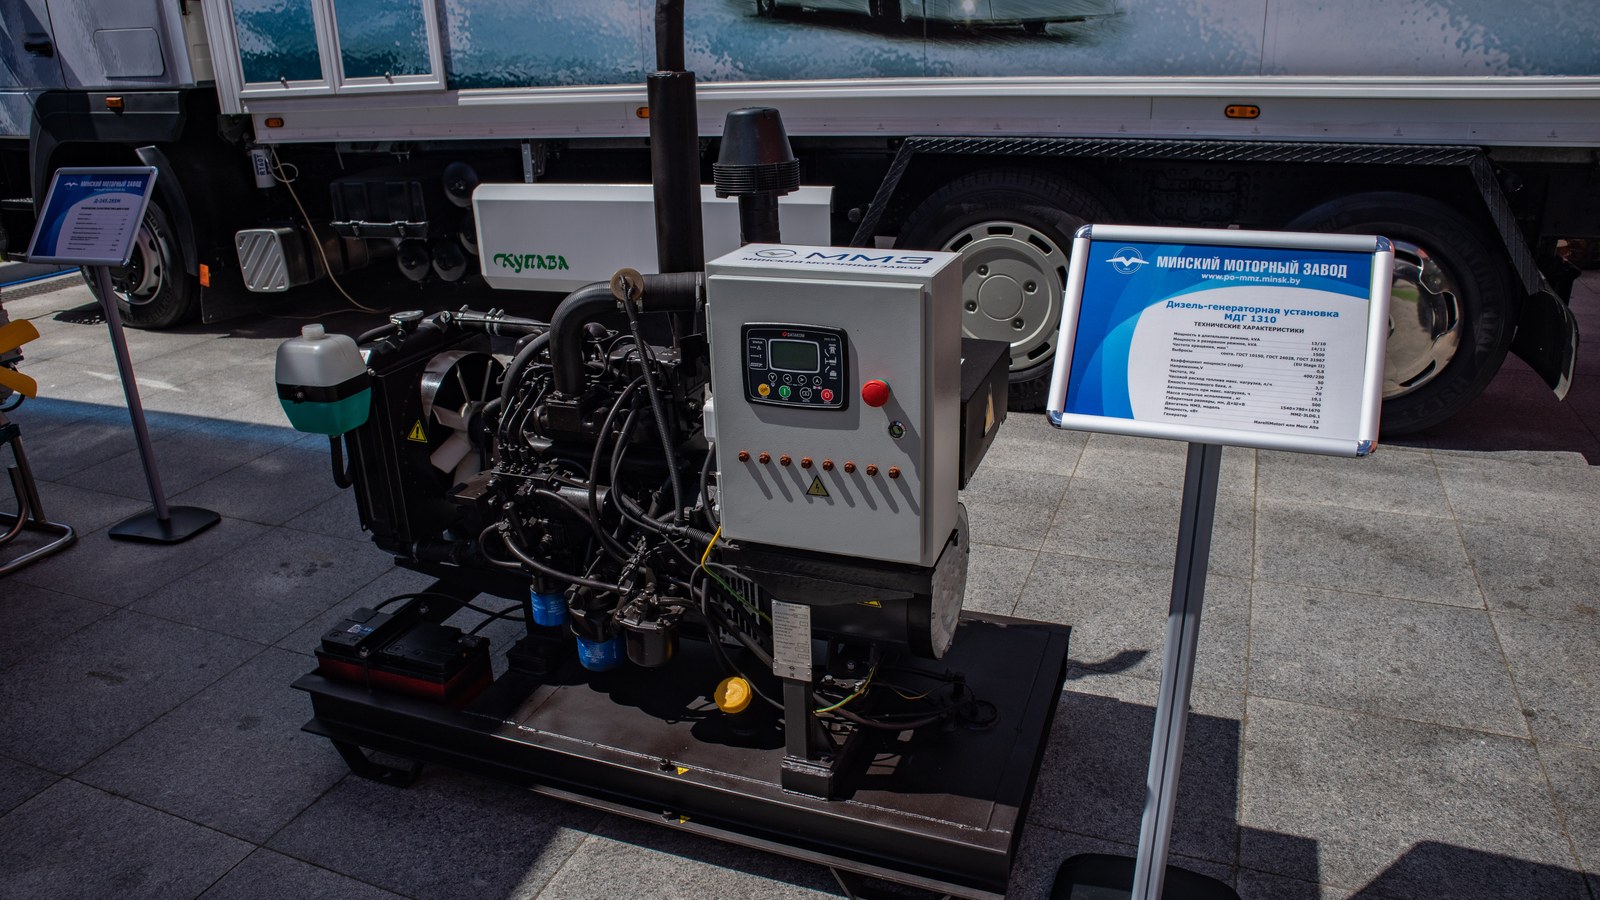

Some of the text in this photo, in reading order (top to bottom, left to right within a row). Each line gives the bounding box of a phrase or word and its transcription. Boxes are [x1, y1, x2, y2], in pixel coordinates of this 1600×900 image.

[805, 252, 934, 264] ММЗ
[806, 260, 878, 269] МОТОРНЫЙ
[1156, 256, 1347, 278] МИНСКИЙ МОТОРНЫЙ ЗАВОД
[1201, 273, 1301, 285] www.po-mmz.minsk.by
[1166, 300, 1340, 318] Дизель-генераторная установка
[1224, 313, 1277, 323] МДГ 1310
[1194, 321, 1305, 334] ТЕХНИЧЕСКИЕ ХАРАКТЕРИСТИКИ
